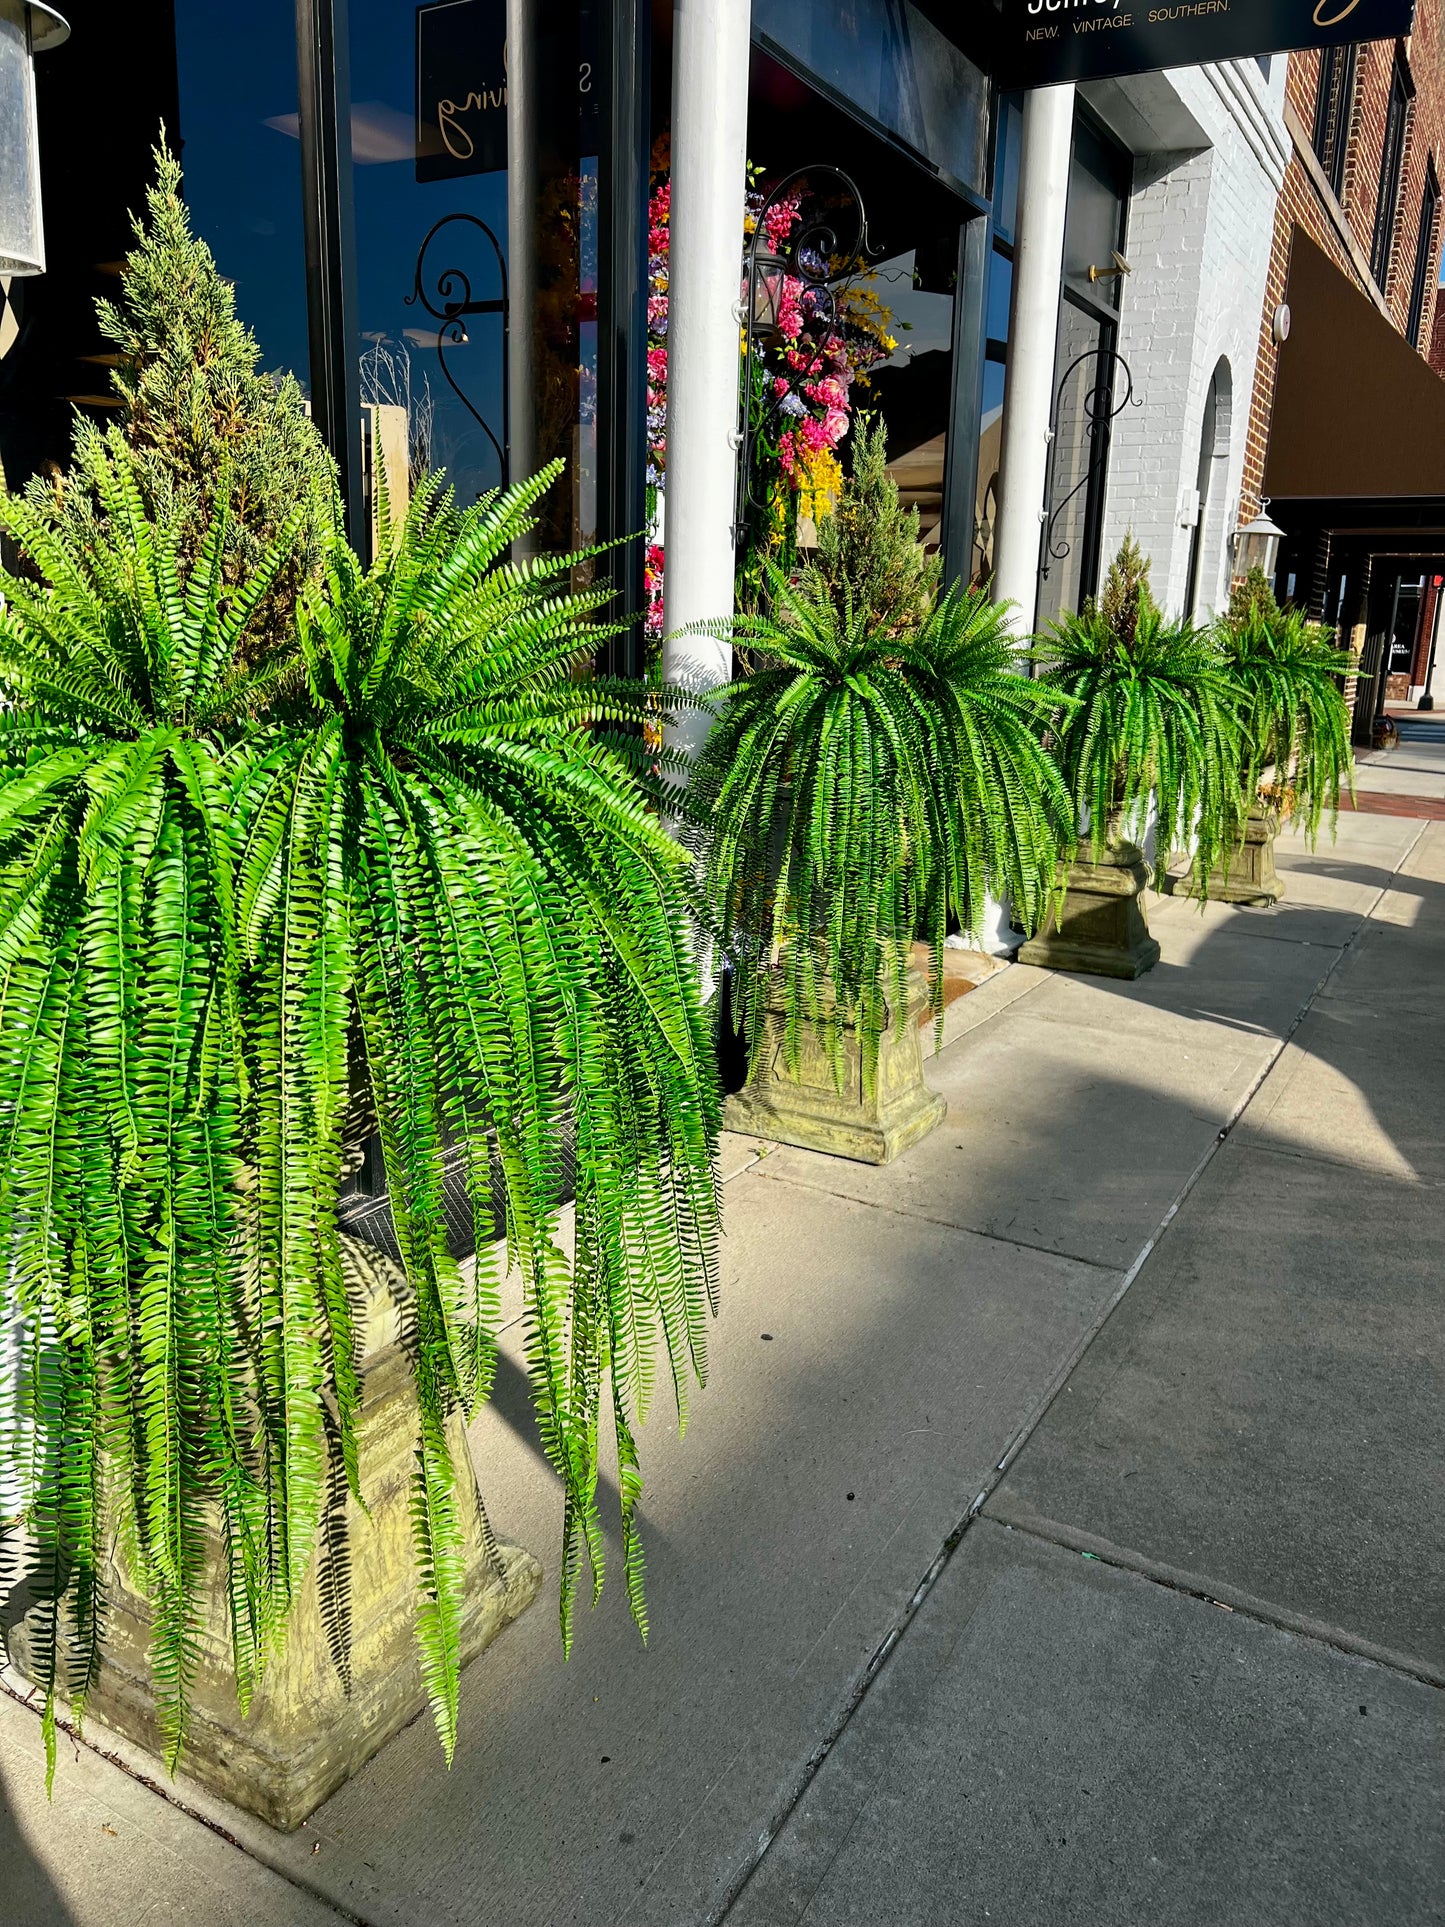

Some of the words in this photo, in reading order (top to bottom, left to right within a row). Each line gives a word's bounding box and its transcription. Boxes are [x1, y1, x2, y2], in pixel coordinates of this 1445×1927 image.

[1025, 25, 1060, 42] NEW.
[1072, 13, 1135, 34] VINTAGE.
[1147, 0, 1231, 23] SOUTHERN.
